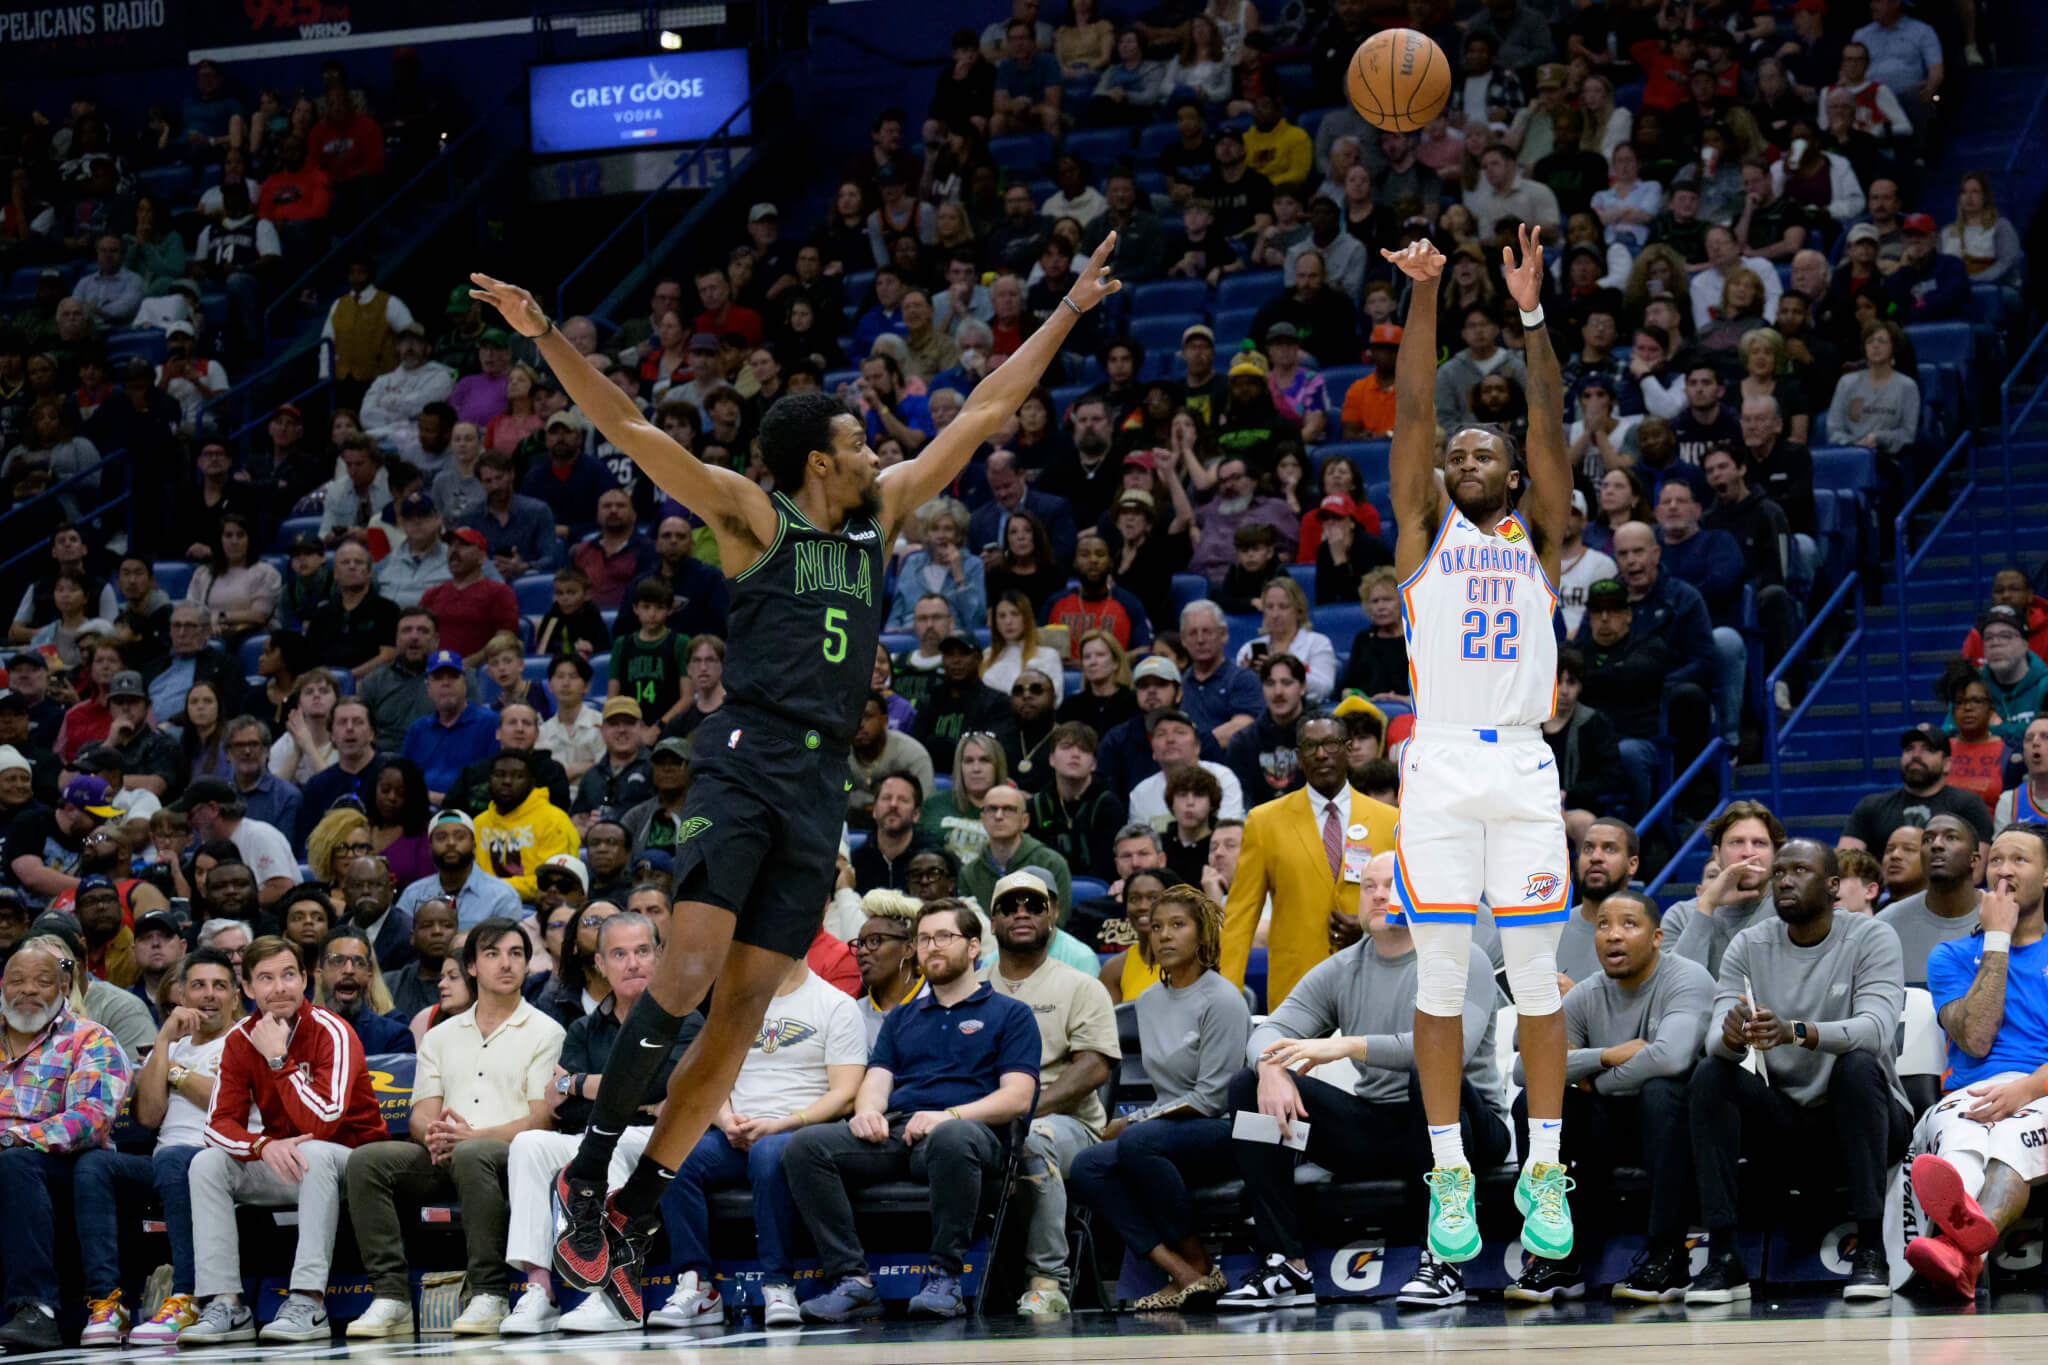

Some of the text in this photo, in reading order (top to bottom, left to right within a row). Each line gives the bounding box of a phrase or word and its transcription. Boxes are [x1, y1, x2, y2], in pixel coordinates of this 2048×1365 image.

[0, 0, 166, 43] PELICANS RADIO
[298, 20, 353, 40] WRNO
[570, 77, 705, 109] GREY GOOSE
[614, 108, 664, 123] VODKA
[794, 539, 873, 608] NOLA
[1439, 544, 1537, 582] OKLAHOMA
[1466, 575, 1516, 605] CITY
[822, 606, 849, 664] 5
[1460, 607, 1521, 663] 22
[636, 679, 657, 704] 14
